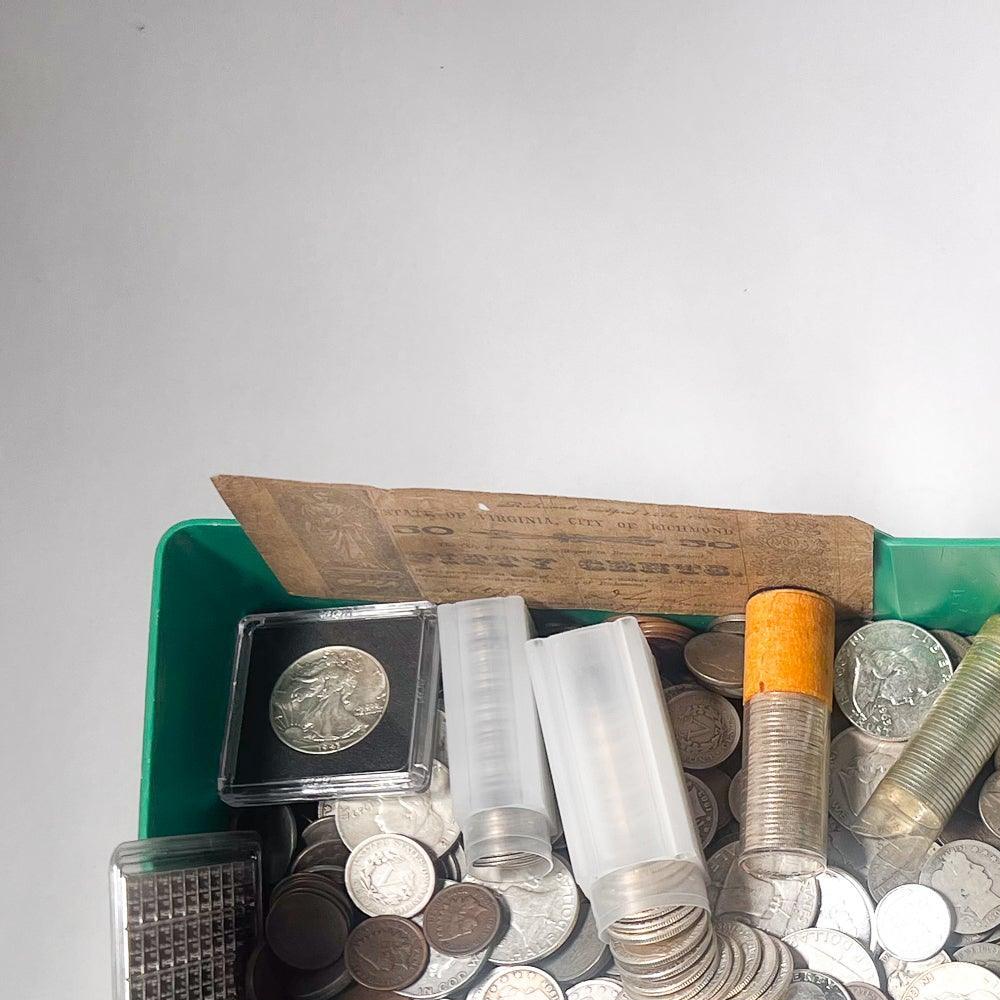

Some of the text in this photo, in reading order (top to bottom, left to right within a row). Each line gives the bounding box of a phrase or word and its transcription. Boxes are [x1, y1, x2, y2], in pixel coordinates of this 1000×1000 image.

[392, 525, 739, 549] 50 50
[568, 517, 602, 528] CITY
[617, 522, 638, 530] OF
[651, 524, 734, 536] RICHMOND
